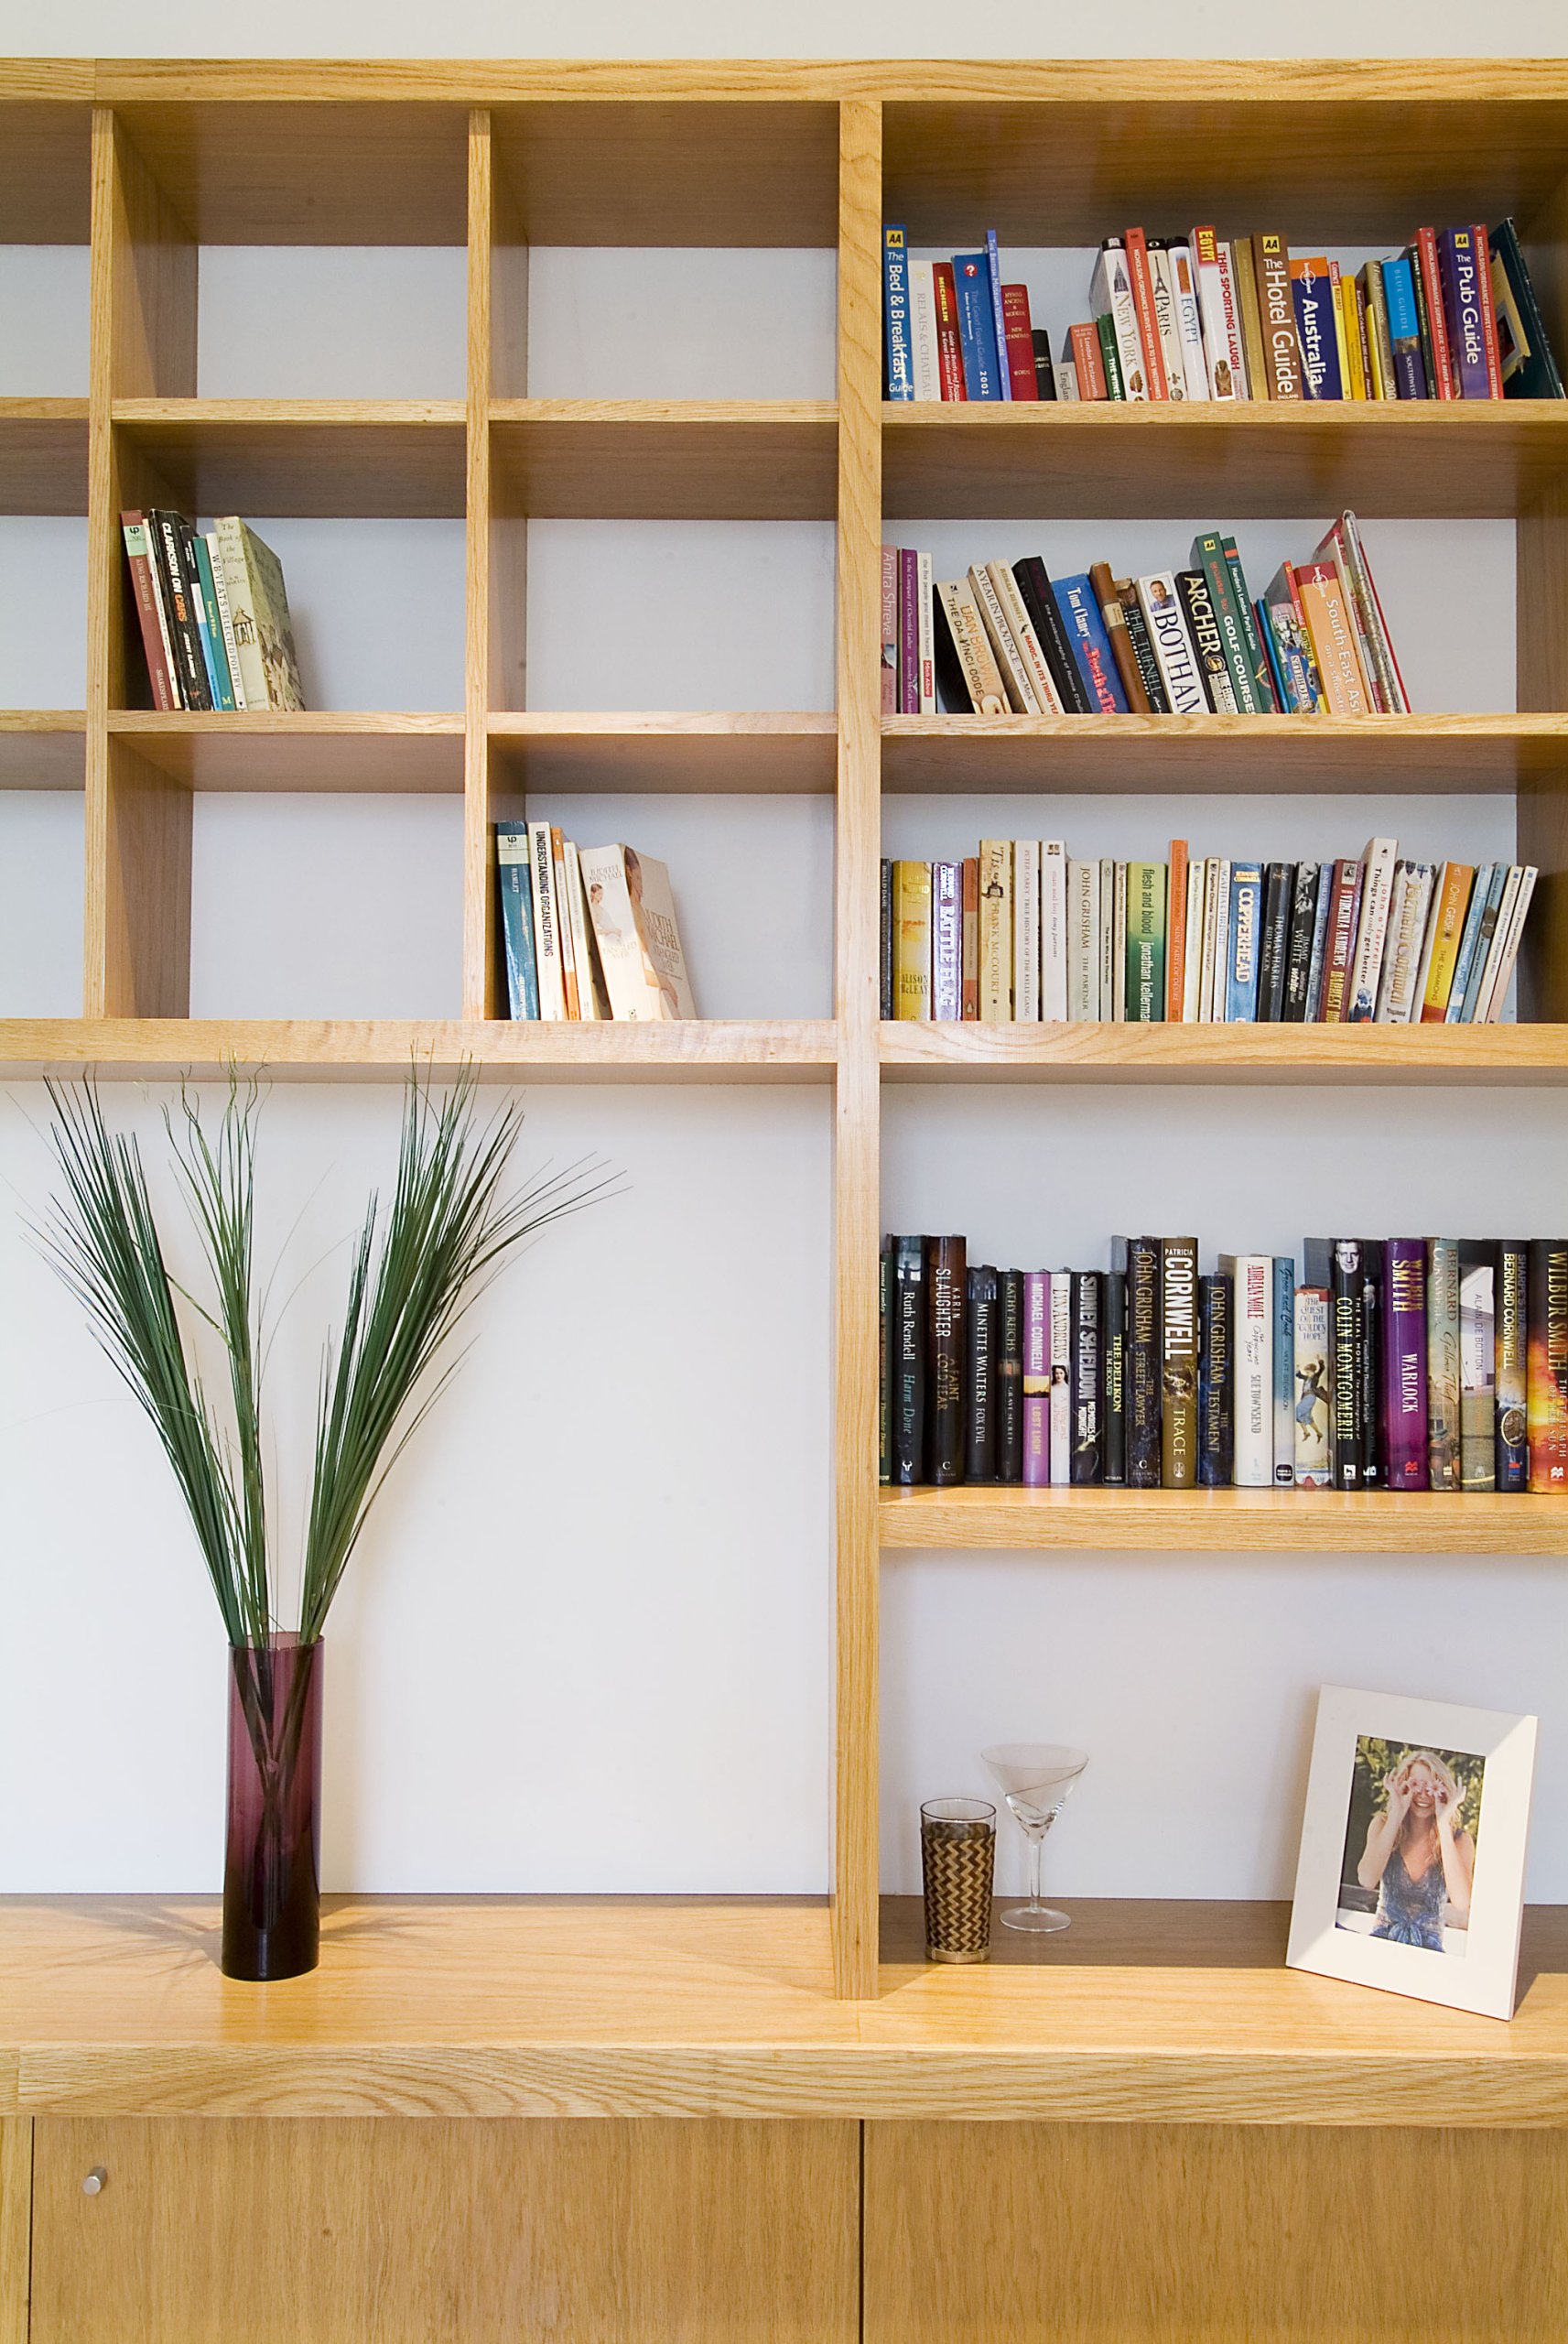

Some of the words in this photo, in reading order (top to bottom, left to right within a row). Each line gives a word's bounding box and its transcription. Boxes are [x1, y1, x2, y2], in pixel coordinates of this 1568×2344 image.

[889, 233, 902, 244] AA
[1198, 231, 1216, 262] EGYPT
[1264, 239, 1279, 250] AA
[1455, 235, 1468, 246] AA
[887, 252, 904, 262] The
[1217, 251, 1228, 274] THIS
[1263, 258, 1283, 268] The
[1455, 255, 1472, 264] The
[889, 265, 905, 291] Bed
[1457, 266, 1476, 303] Pub
[893, 295, 905, 307] &
[938, 277, 949, 321] MICHELIN
[1115, 293, 1132, 327] NEW
[1220, 277, 1236, 330] SPORTING
[1265, 270, 1291, 324] Hotel
[1393, 269, 1404, 293] BLUE
[1399, 298, 1409, 331] GUIDE
[972, 305, 982, 326] Good
[1154, 296, 1171, 336] PARIS
[1182, 298, 1198, 345] EGYPT
[891, 309, 907, 379] Breakfast
[974, 327, 984, 345] Food
[1084, 337, 1093, 360] London
[1121, 329, 1138, 368] YORK
[1227, 333, 1240, 370] LAUGH
[1303, 298, 1326, 385] Australia
[1462, 307, 1481, 364] Guide
[977, 347, 987, 368] Guide
[1271, 331, 1298, 394] Guide
[1405, 355, 1416, 396] SOUTHWEST
[889, 383, 914, 393] Guide
[979, 371, 989, 396] 2002
[1087, 360, 1098, 397] Restaurants
[135, 559, 145, 574] KING
[161, 522, 180, 577] CLARKSON
[139, 574, 150, 602] RICHARD
[173, 578, 183, 593] ON
[883, 552, 895, 589] Anita
[1231, 567, 1242, 593] Harden's
[174, 594, 188, 623] CARS
[882, 591, 895, 635] Shreve
[1066, 587, 1082, 609] Tom
[1076, 608, 1090, 638] Clancy
[1184, 576, 1221, 656] ARCHER
[1238, 593, 1247, 616] London
[1293, 600, 1305, 626] Essential
[1224, 615, 1240, 652] GOLF
[1242, 616, 1251, 632] Party
[1248, 633, 1257, 651] Guide
[183, 632, 192, 653] JEREMY
[188, 654, 196, 678] CLARKSON
[221, 609, 235, 654] SELECTED
[229, 655, 242, 689] POETRY
[959, 605, 980, 634] DAN
[970, 636, 995, 686] BROWN
[1128, 609, 1145, 635] PHIL
[1138, 638, 1162, 695] TUFNELL
[1153, 610, 1200, 713] BOTHAM
[1325, 599, 1355, 683] South-East
[1347, 689, 1364, 712] Asi
[512, 867, 520, 894] HAMLET
[535, 830, 549, 895] UNDERSTANDING
[1080, 868, 1091, 897] JOHN
[1371, 867, 1382, 897] Things
[540, 895, 554, 957] ORGANIZATIONS
[1081, 900, 1091, 949] GRISHAM
[1336, 895, 1353, 928] VIRGINIA
[1365, 917, 1375, 937] only
[939, 905, 955, 963] BATTLE
[1235, 887, 1254, 982] COPPERHEAD
[1273, 915, 1285, 953] THOMAS
[1292, 928, 1304, 963] WHITE
[1301, 935, 1310, 961] JIMMY
[1333, 928, 1349, 967] ANDREWS
[1364, 937, 1372, 951] get
[939, 967, 955, 1006] FLAG
[1271, 956, 1281, 989] HARRIS
[1360, 954, 1371, 983] better
[1327, 971, 1346, 1009] DARKEST
[1133, 1250, 1153, 1286] JOHN
[1164, 1247, 1194, 1256] PATRICIA
[1248, 1264, 1265, 1296] ADRIAN
[1391, 1259, 1411, 1312] SMITH
[1410, 1259, 1423, 1311] WILBUR
[1445, 1248, 1457, 1321] BERNARD
[1503, 1253, 1515, 1307] BERNARD
[903, 1291, 915, 1318] Ruth
[935, 1268, 951, 1338] SLAUGHTER
[952, 1287, 961, 1319] KARIN
[1006, 1282, 1016, 1315] KATHY
[1031, 1283, 1044, 1322] MICHAEL
[1053, 1289, 1068, 1308] LYN
[1079, 1275, 1098, 1329] SIDNEY
[1135, 1287, 1153, 1343] GRISHAM
[1164, 1256, 1194, 1361] CORNWELL
[1207, 1286, 1226, 1321] JOHN
[1248, 1297, 1265, 1319] MOLE
[1474, 1294, 1483, 1318] ALAIN
[976, 1303, 989, 1351] MINETTE
[1006, 1317, 1016, 1352] REICHS
[1053, 1309, 1068, 1360] ANDREWS
[1336, 1297, 1353, 1338] COLIN
[1474, 1322, 1483, 1335] DE
[903, 1320, 915, 1361] Rendell
[1031, 1327, 1044, 1372] CONNELLY
[1113, 1333, 1122, 1359] THE
[1210, 1324, 1226, 1384] GRISHAM
[1474, 1337, 1483, 1371] BOTTON
[1503, 1308, 1515, 1371] CORNWELL
[976, 1356, 989, 1403] WALTERS
[1078, 1330, 1097, 1400] SHELDON
[1135, 1351, 1145, 1383] STREET
[1250, 1374, 1262, 1390] SUE
[1401, 1353, 1419, 1413] WARLOCK
[903, 1374, 915, 1403] Harm
[1113, 1361, 1122, 1413] DELIKON
[1336, 1342, 1353, 1440] MONTGOMERIE
[903, 1406, 914, 1434] Done
[976, 1408, 986, 1424] FOX
[1032, 1405, 1042, 1427] LOST
[1087, 1401, 1097, 1430] MEMORIES
[1135, 1388, 1145, 1427] LAWYER
[1208, 1388, 1220, 1453] TESTAMENT
[1220, 1412, 1228, 1428] THE
[1250, 1390, 1262, 1434] TOWNSEND
[976, 1426, 986, 1444] EVIL
[1032, 1429, 1042, 1454] LIGHT
[1087, 1431, 1097, 1443] OF
[1173, 1407, 1186, 1457] TRACE
